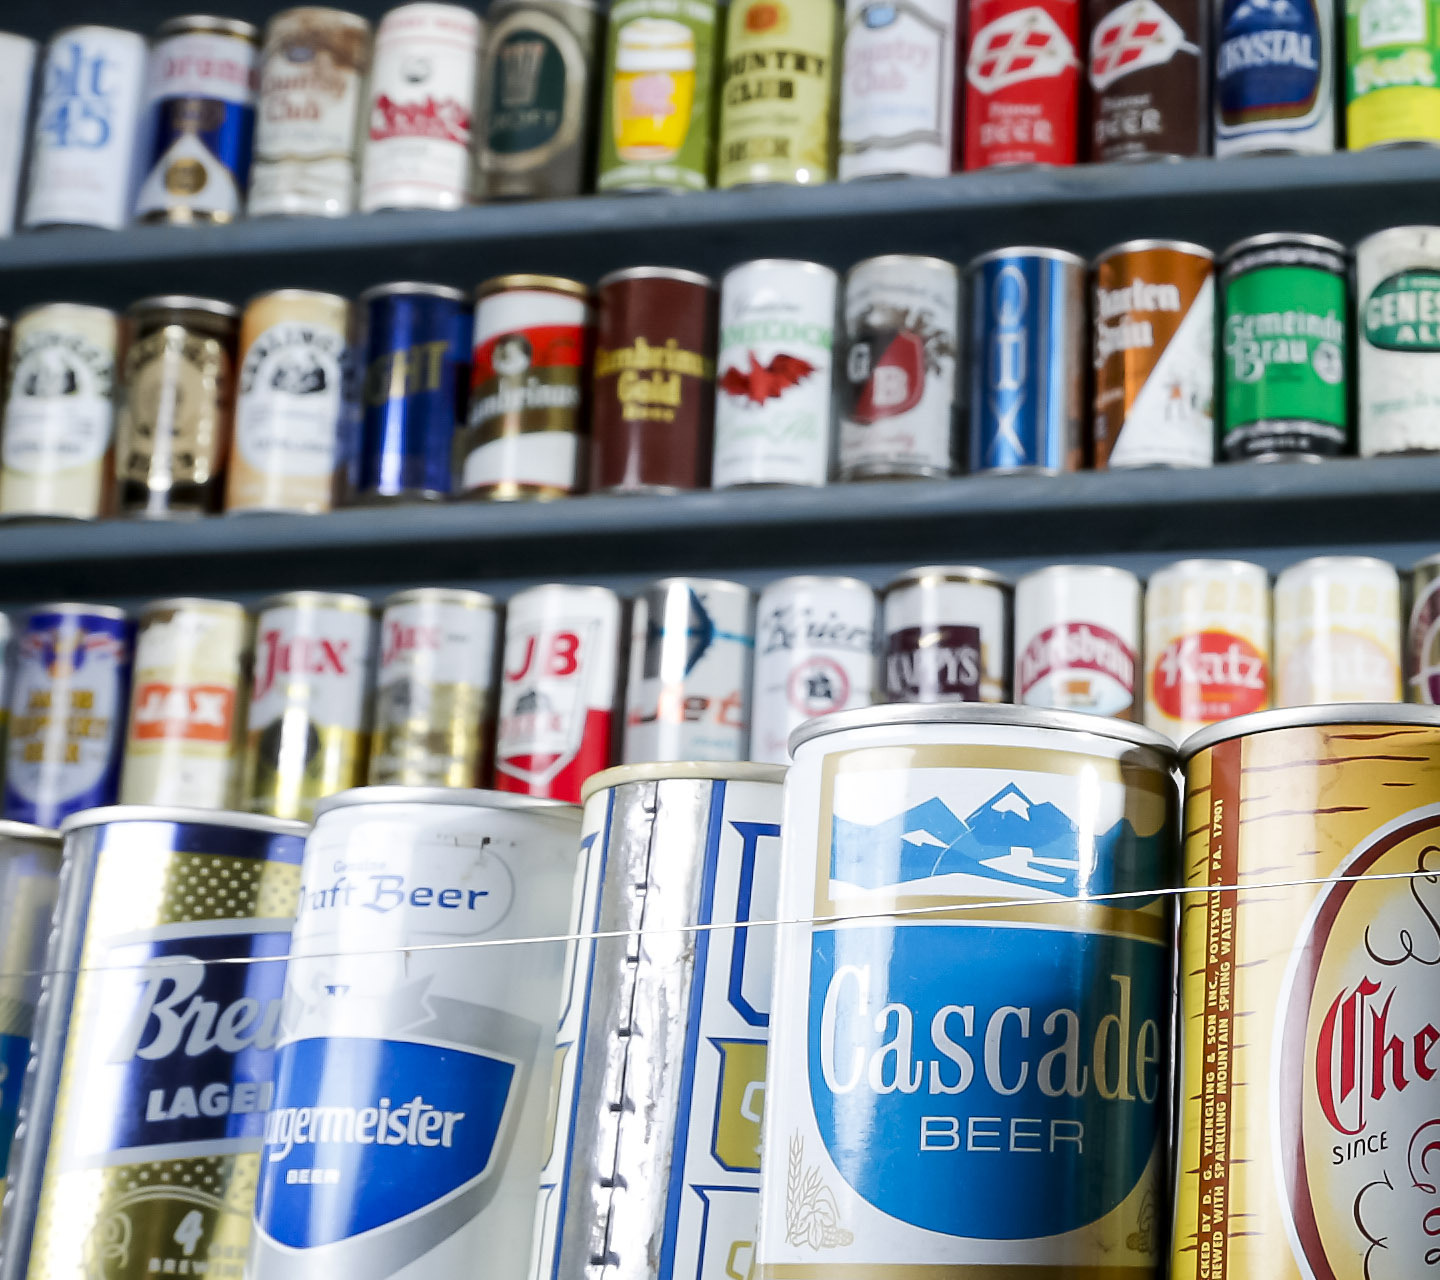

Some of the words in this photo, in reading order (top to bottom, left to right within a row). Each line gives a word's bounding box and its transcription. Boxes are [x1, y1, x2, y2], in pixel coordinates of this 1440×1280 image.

[616, 372, 682, 408] Gold
[254, 628, 349, 707] Jax
[1162, 633, 1266, 692] Katz
[1214, 799, 1223, 837] 17901
[1212, 845, 1222, 870] PA.
[362, 874, 490, 915] Beer
[1210, 876, 1222, 964] POTTSVILL,
[1221, 907, 1232, 955] WATER
[1219, 961, 1231, 1011] SPRING
[820, 965, 1160, 1105] Cascade
[1207, 1013, 1216, 1043] SON
[1206, 1052, 1215, 1063] &
[1217, 1017, 1229, 1094] MOUNTAIN
[264, 1094, 467, 1164] urgermeister
[1202, 1070, 1216, 1157] YUENGLING
[920, 1116, 1086, 1155] BEER
[1214, 1101, 1227, 1179] SPARKLING
[1332, 1131, 1389, 1165] SINCE
[286, 1168, 341, 1186] BEER
[1203, 1164, 1212, 1181] G.
[1202, 1188, 1212, 1204] D.
[1213, 1185, 1224, 1224] WITH
[173, 1208, 204, 1257] 4
[1201, 1213, 1211, 1233] BY
